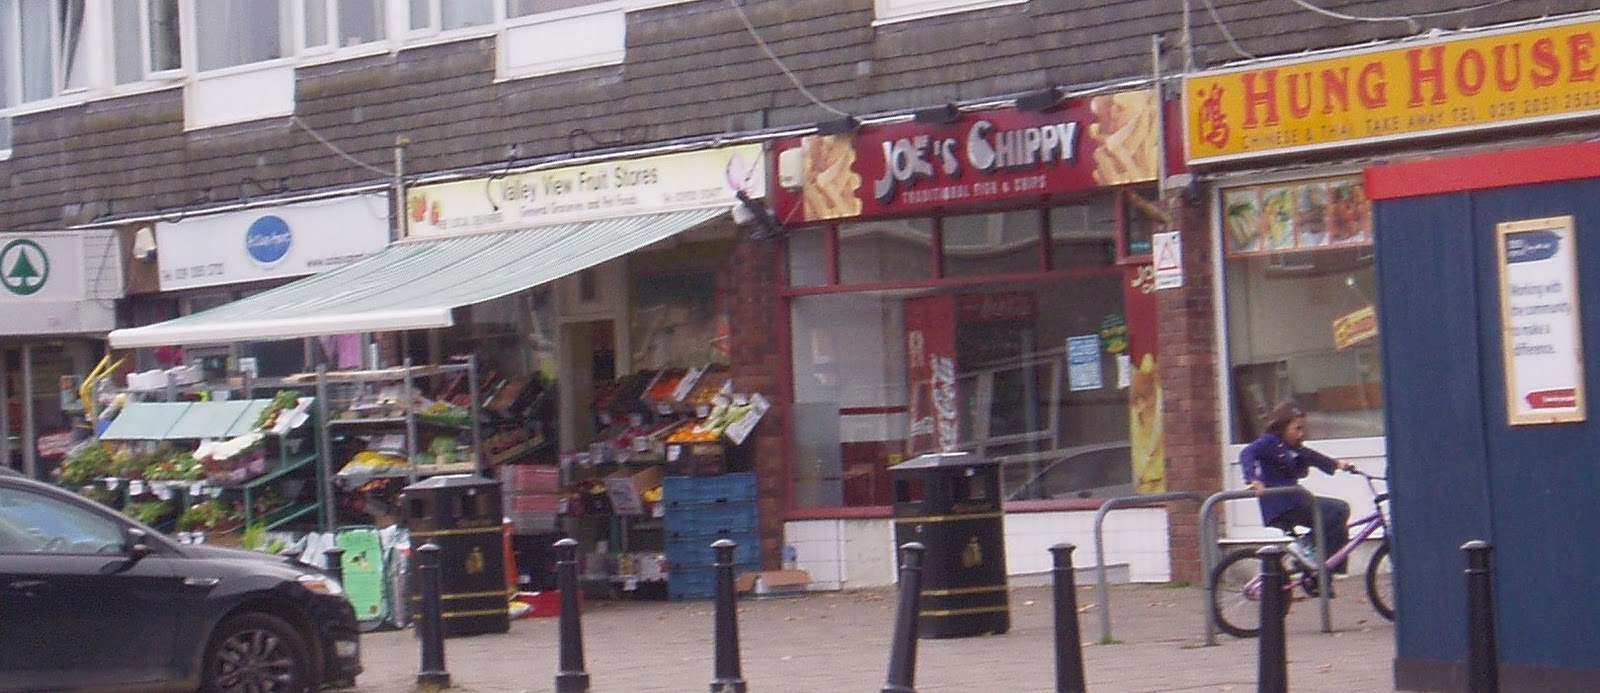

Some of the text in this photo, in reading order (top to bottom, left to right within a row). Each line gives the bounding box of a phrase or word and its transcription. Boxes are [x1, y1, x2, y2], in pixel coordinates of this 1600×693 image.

[1241, 31, 1600, 130] HUNG HOUSE
[1365, 115, 1400, 132] TAKE
[1408, 111, 1445, 126] AWAY
[1452, 106, 1477, 122] TEL
[873, 119, 1078, 201] JOE'S CHIPPY
[543, 174, 573, 196] View
[578, 170, 609, 192] Fruit
[614, 165, 659, 188] Stores
[902, 183, 970, 204] TRADITIONAL
